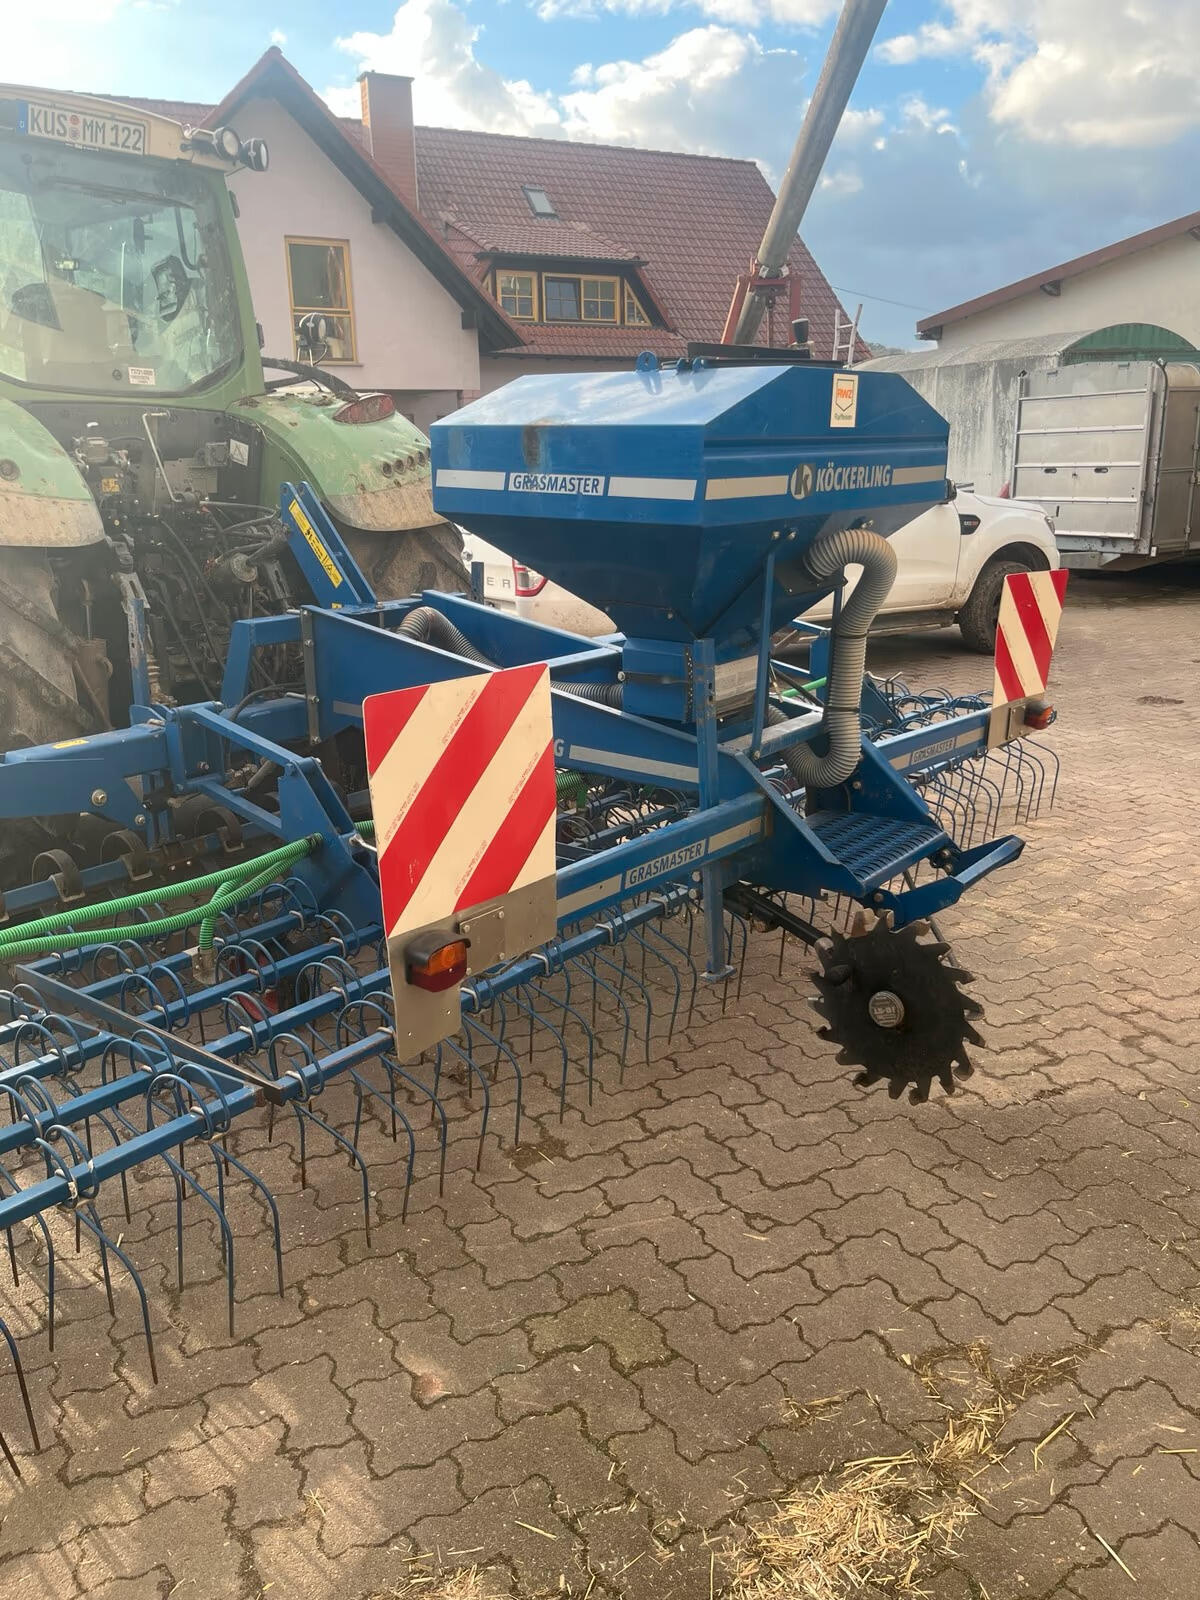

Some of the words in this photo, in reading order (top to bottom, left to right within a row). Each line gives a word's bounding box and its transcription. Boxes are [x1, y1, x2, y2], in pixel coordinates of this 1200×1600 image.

[30, 107, 67, 136] KUS
[83, 119, 106, 144] MM
[110, 124, 143, 151] 122
[513, 474, 600, 494] GRASMASTER
[816, 462, 891, 491] KÖCKERLING
[629, 842, 702, 885] GRASMASTER
